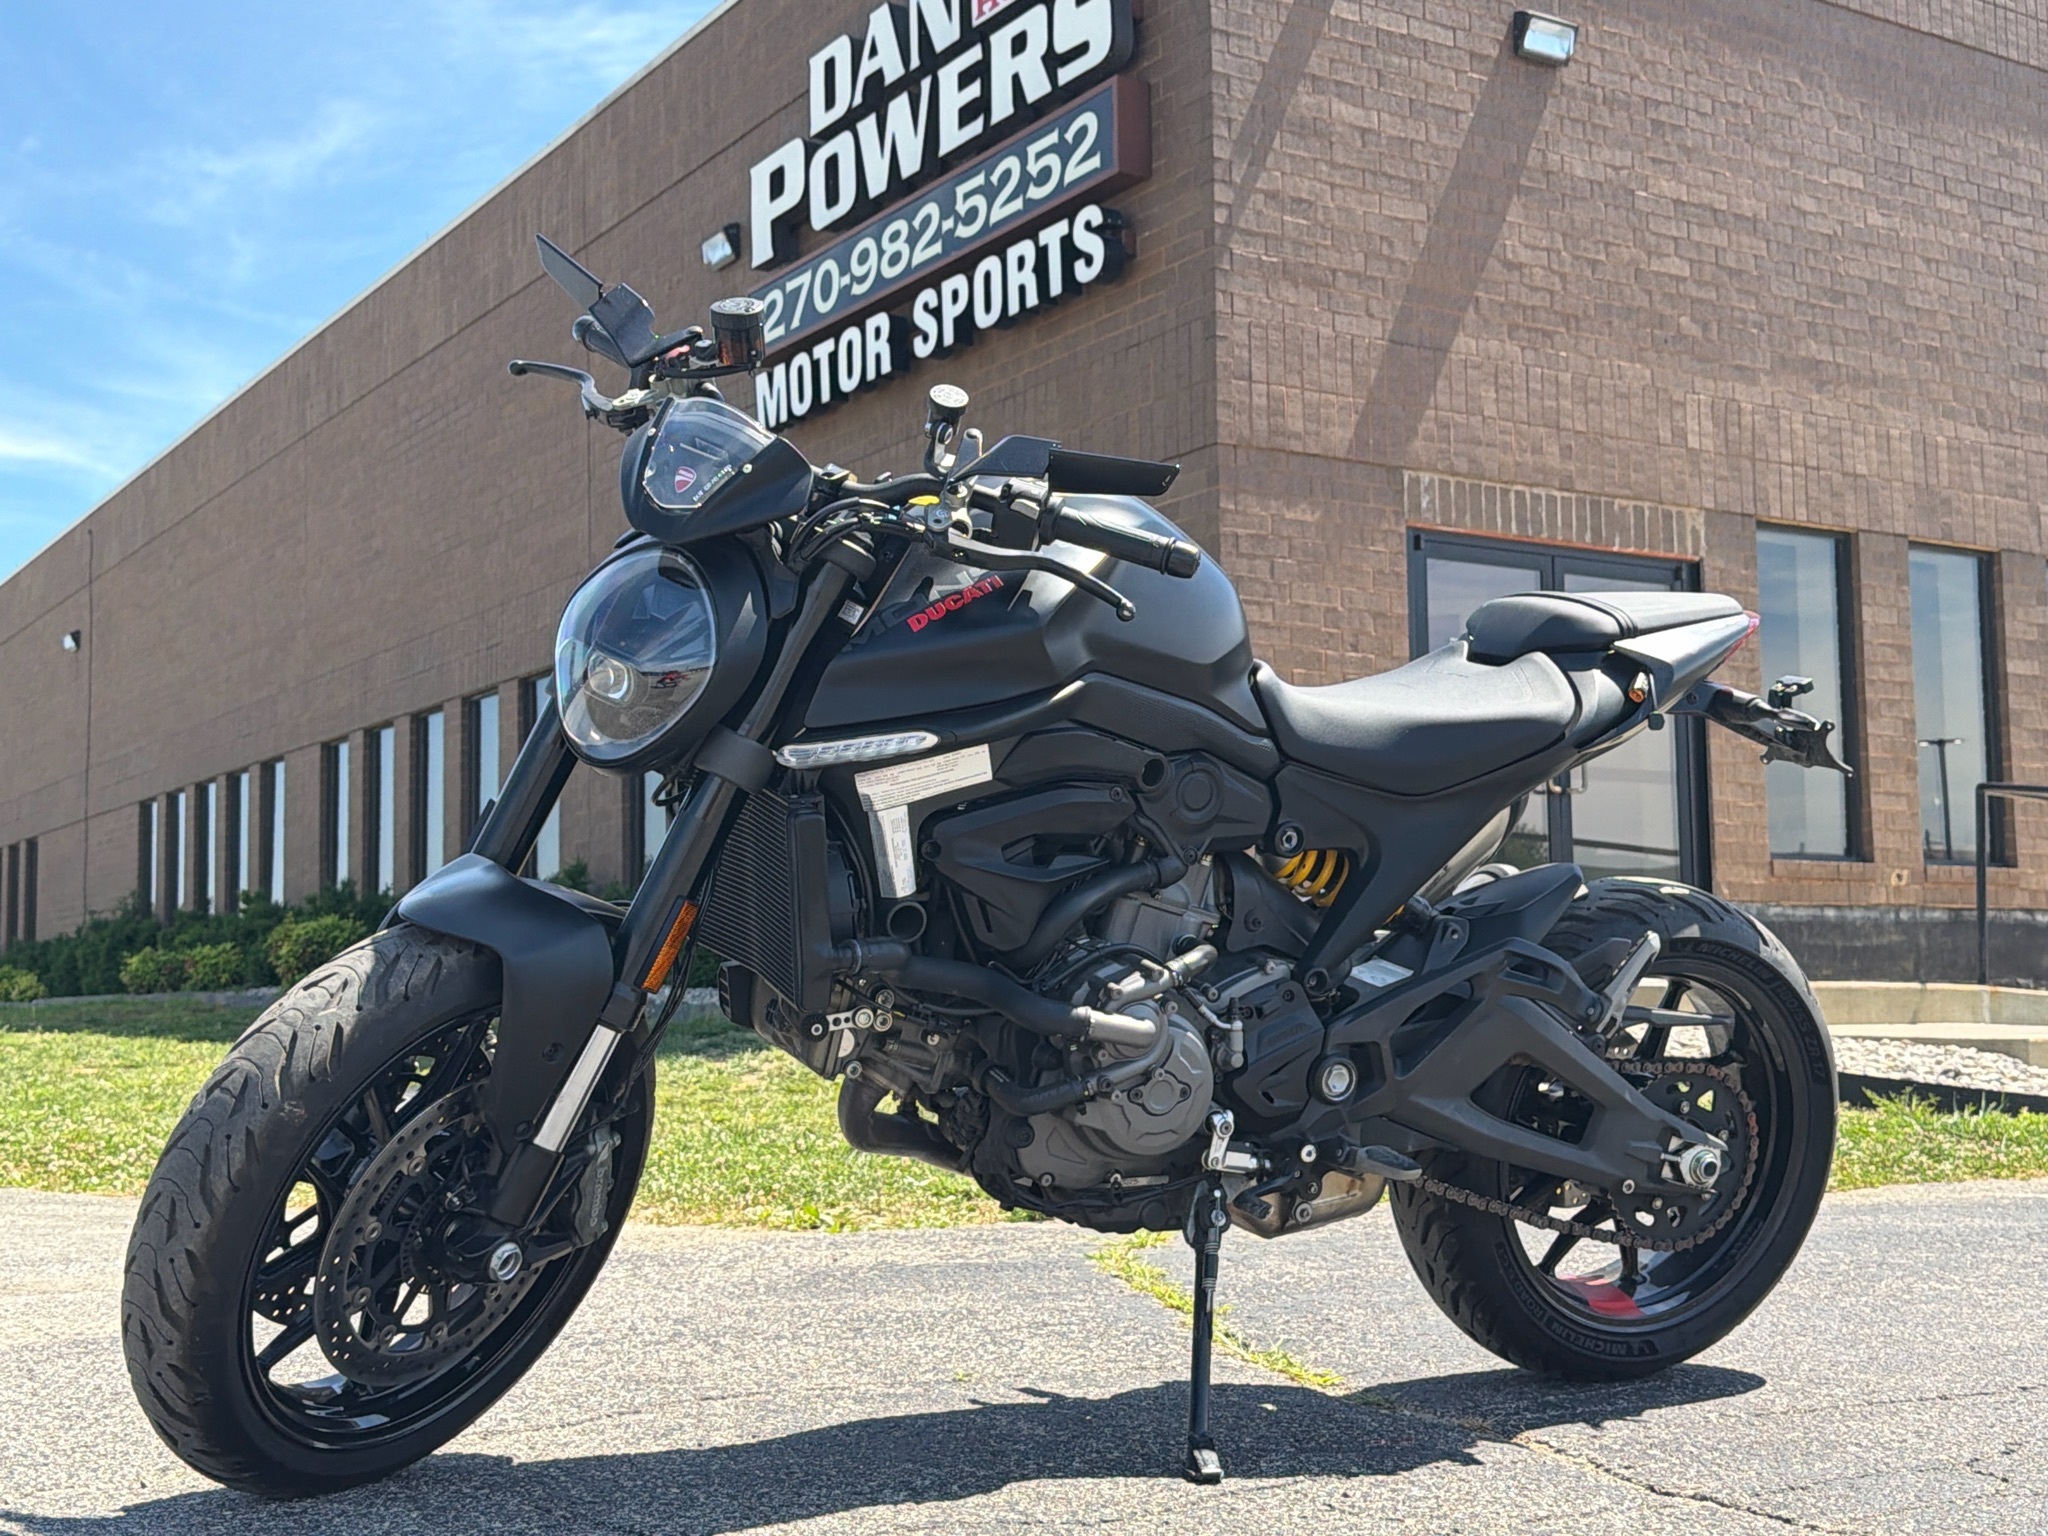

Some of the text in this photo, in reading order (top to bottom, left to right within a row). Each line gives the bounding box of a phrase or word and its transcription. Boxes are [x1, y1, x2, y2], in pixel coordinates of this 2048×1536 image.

[809, 0, 960, 137] DAN
[750, 0, 1112, 269] POWERS
[762, 111, 1101, 344] 270-982-5252
[913, 204, 1104, 358] SPORTS
[755, 311, 892, 429] MOTOR
[906, 574, 1005, 633] DUCATI
[1697, 942, 1774, 985] MICHELIN
[589, 1166, 608, 1227] brembo
[1512, 1280, 1545, 1318] ROAD
[1550, 1321, 1628, 1356] MICHELIN
